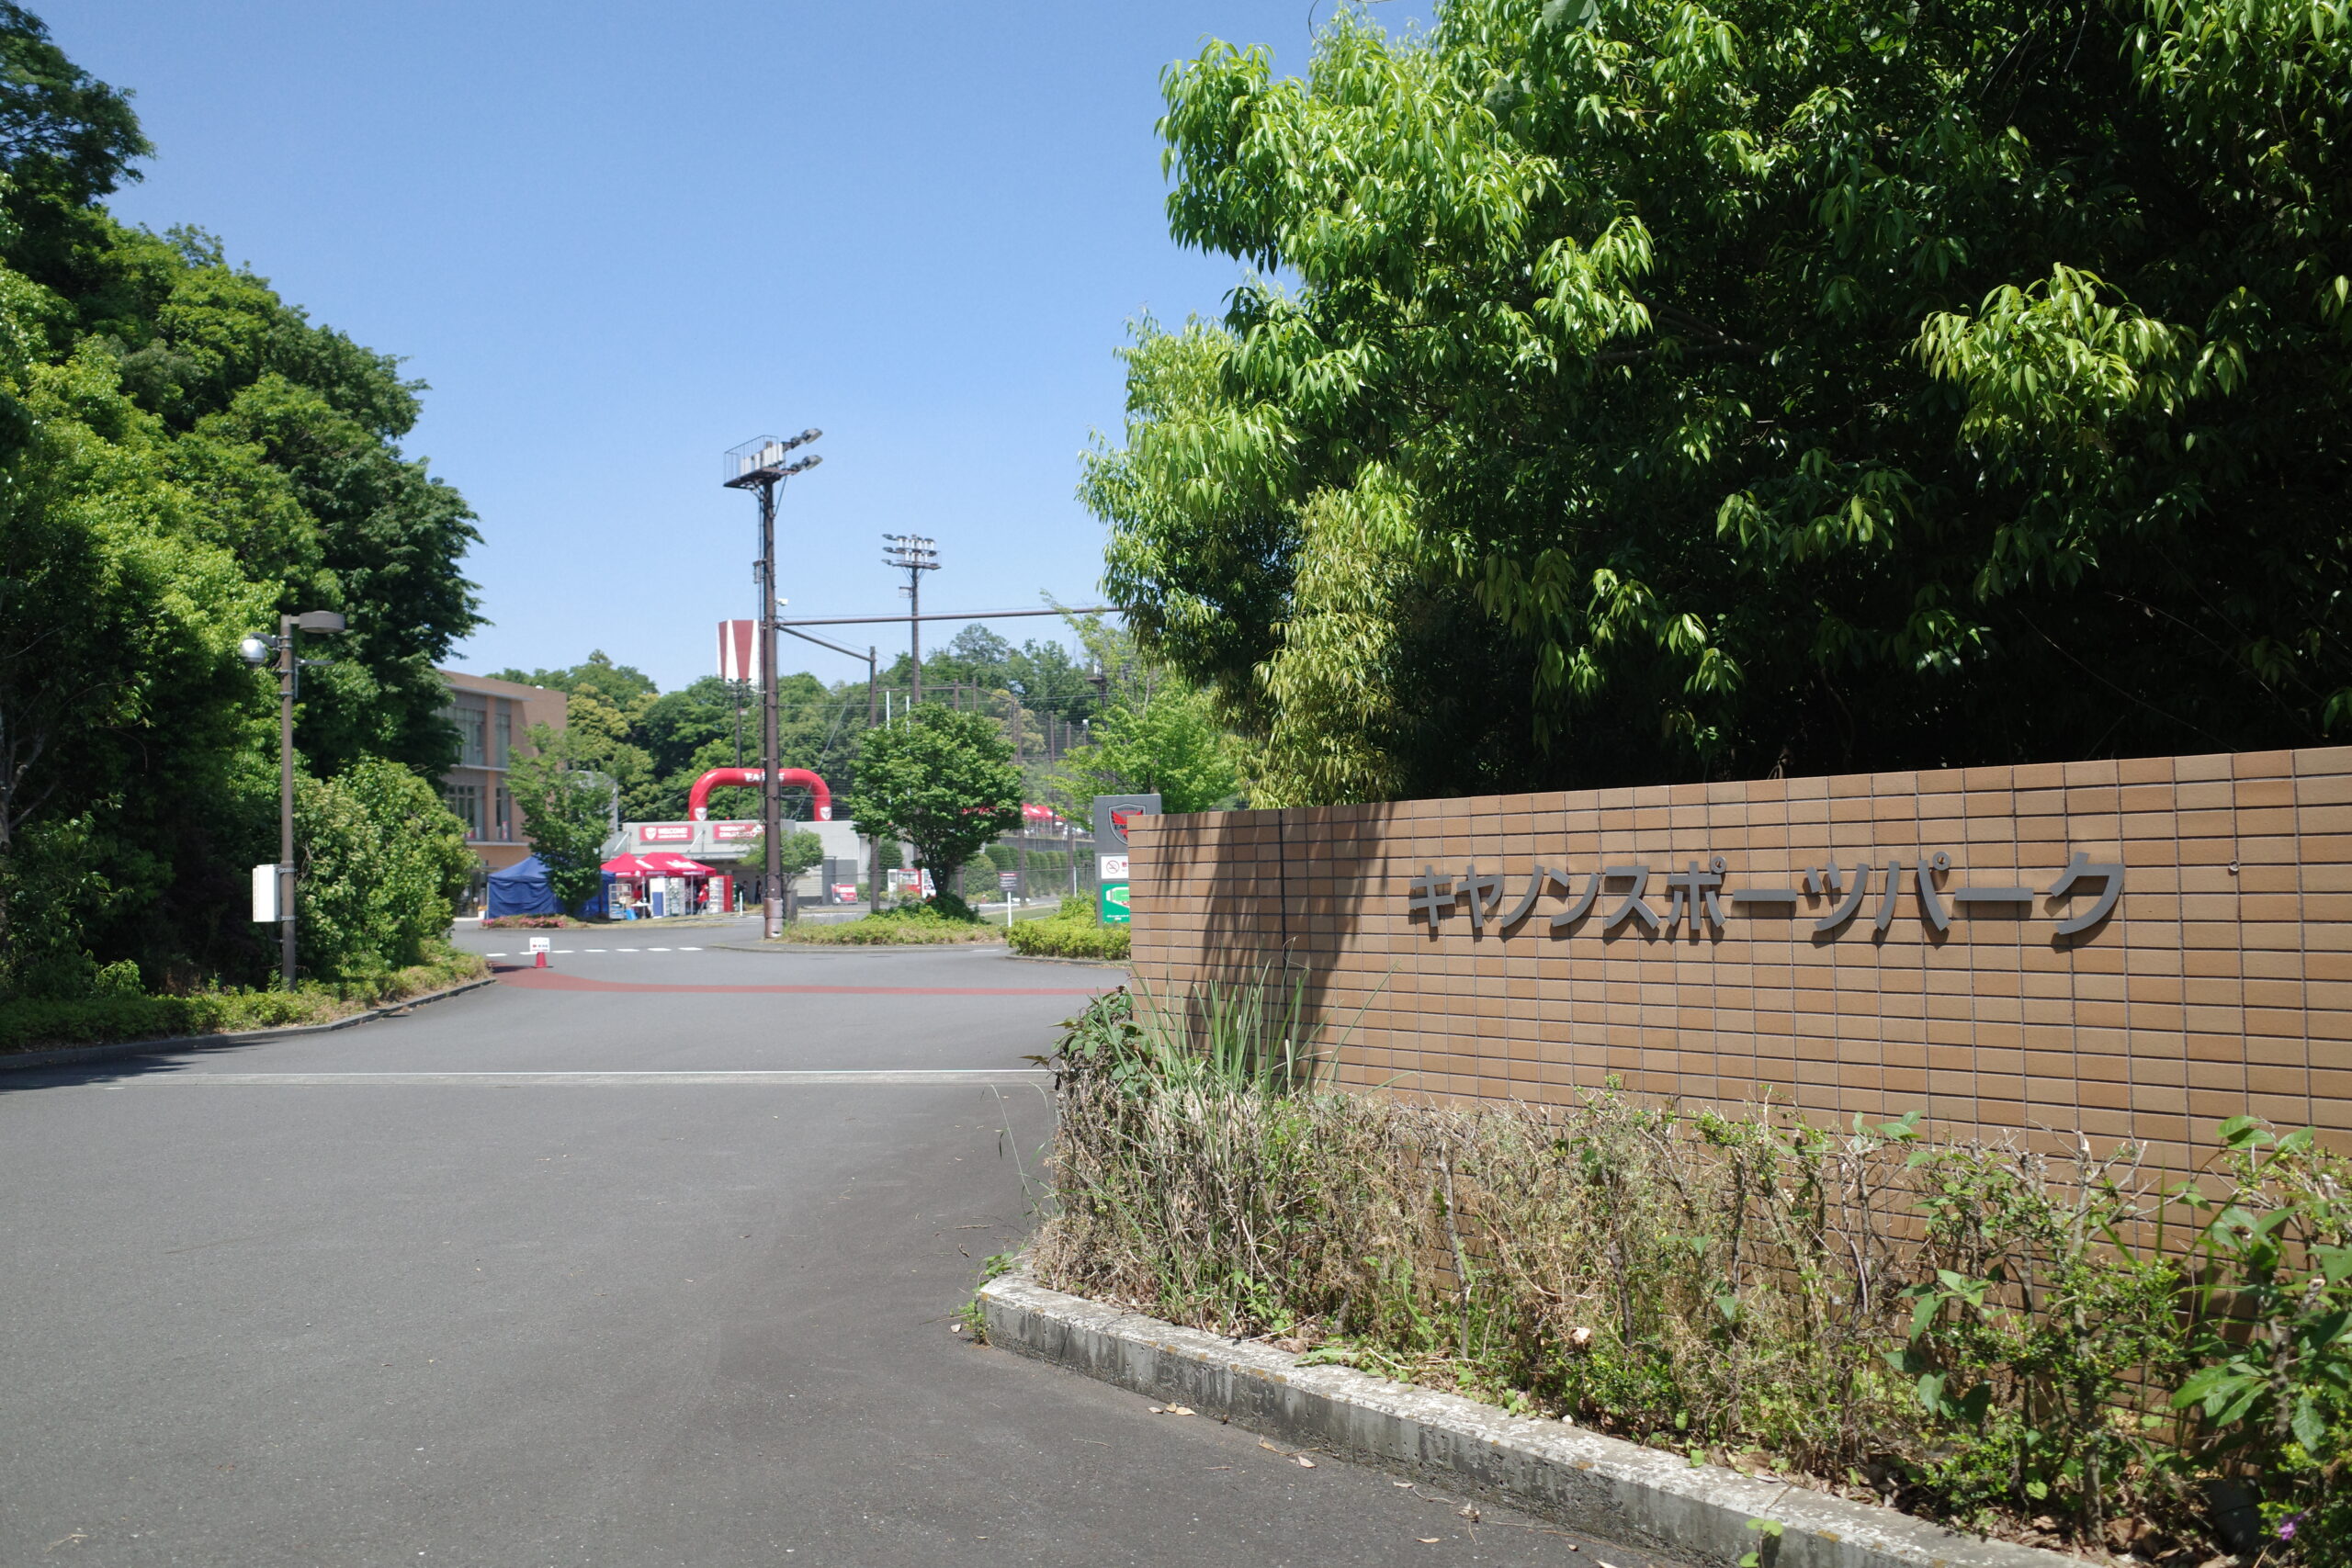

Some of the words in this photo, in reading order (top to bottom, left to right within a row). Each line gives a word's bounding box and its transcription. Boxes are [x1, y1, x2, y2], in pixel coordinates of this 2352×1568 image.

[1408, 851, 2125, 935] キヤノンスポーツパーク
